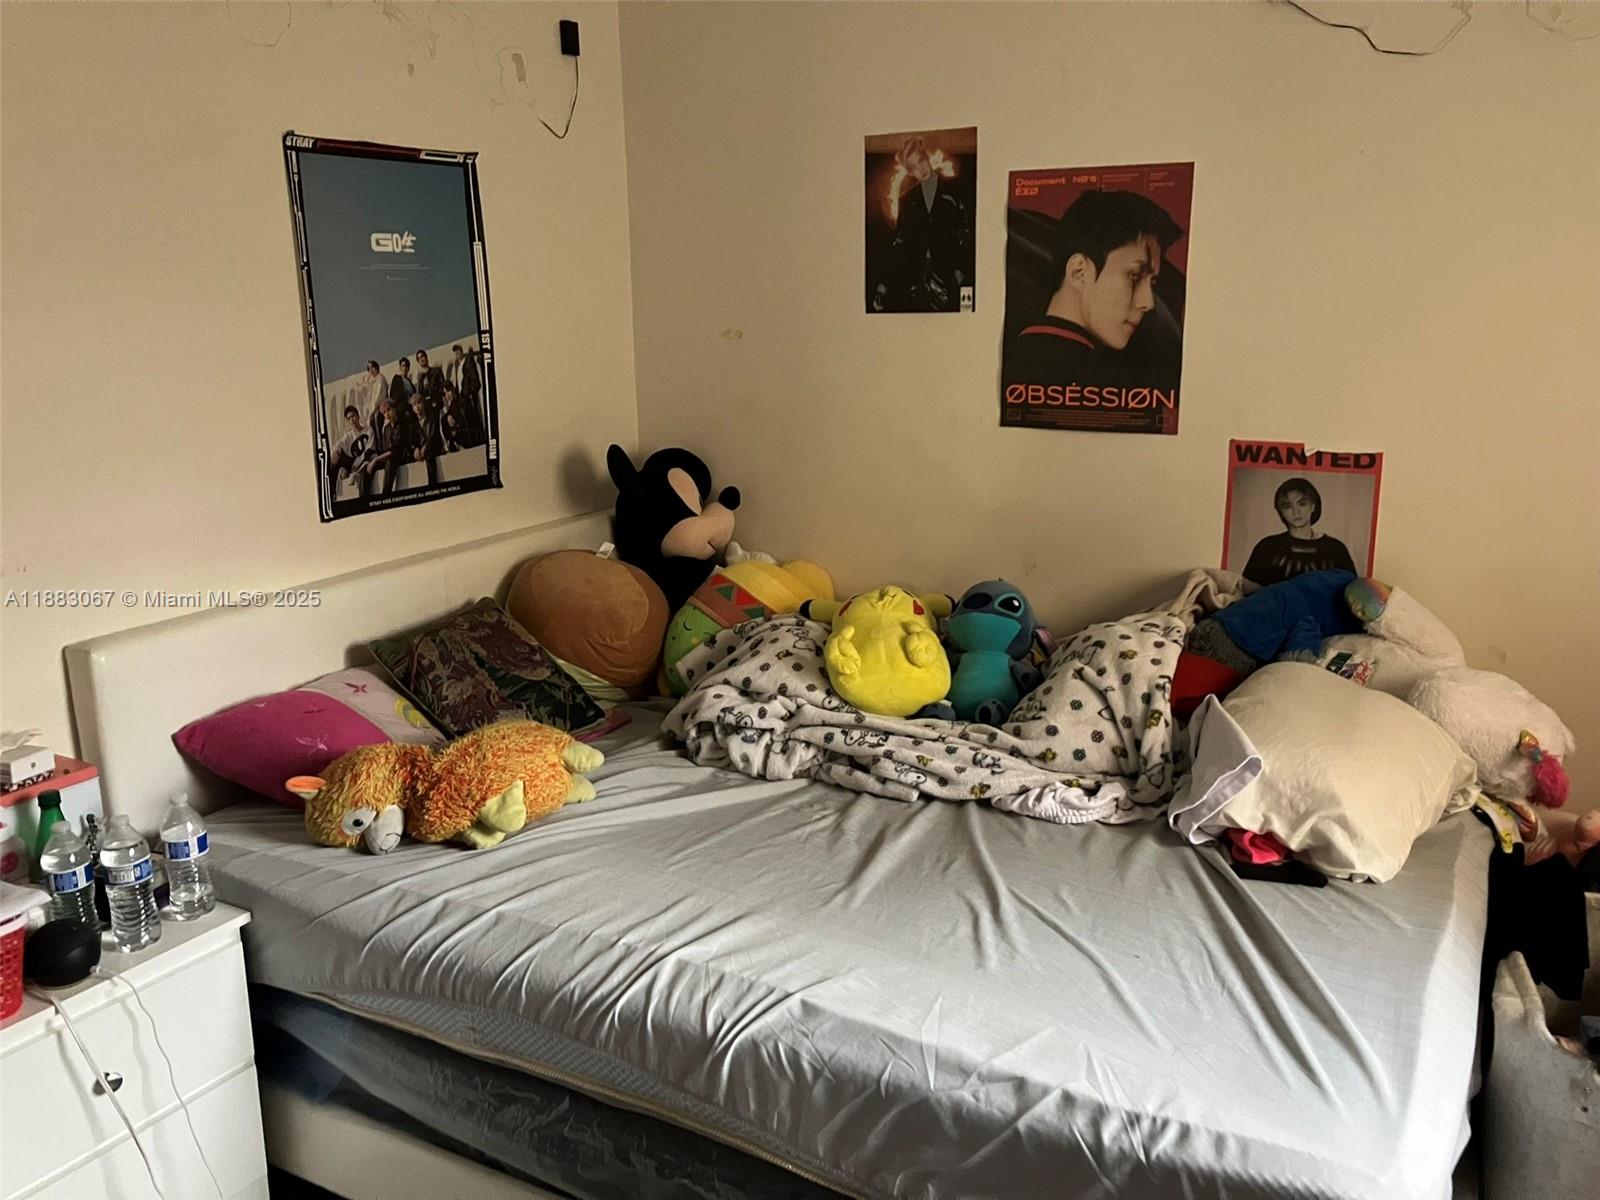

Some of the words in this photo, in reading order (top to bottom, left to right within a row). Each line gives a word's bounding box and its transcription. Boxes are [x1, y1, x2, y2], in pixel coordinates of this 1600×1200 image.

[285, 135, 315, 149] STRAY
[1015, 177, 1066, 187] Document
[481, 333, 491, 350] 1ST
[1235, 444, 1377, 469] WANTED
